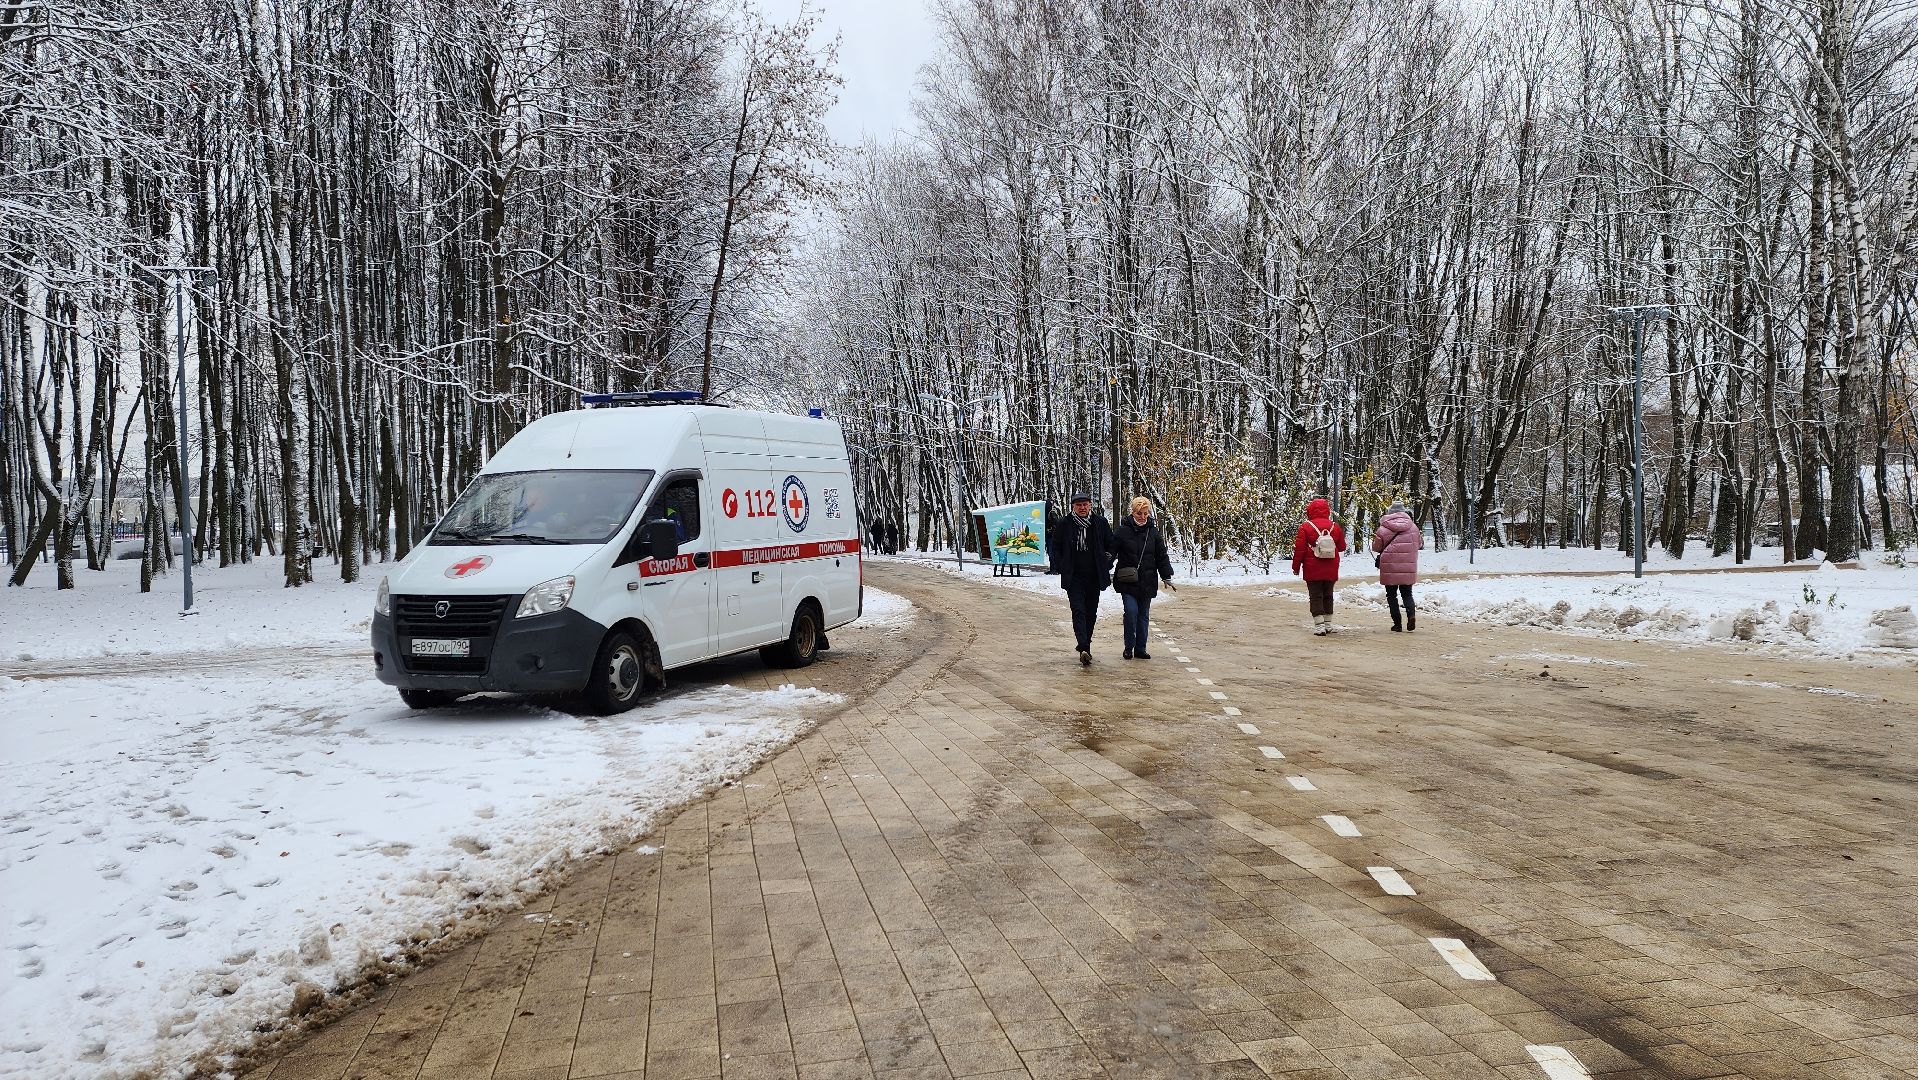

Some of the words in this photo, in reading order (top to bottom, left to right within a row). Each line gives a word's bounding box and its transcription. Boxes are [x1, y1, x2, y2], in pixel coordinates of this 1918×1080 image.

[745, 489, 777, 518] 112
[649, 557, 689, 574] СКОРАЯ
[742, 546, 799, 564] МЕДИЦИНСКАЯ
[819, 541, 846, 553] ПОМОЩЬ
